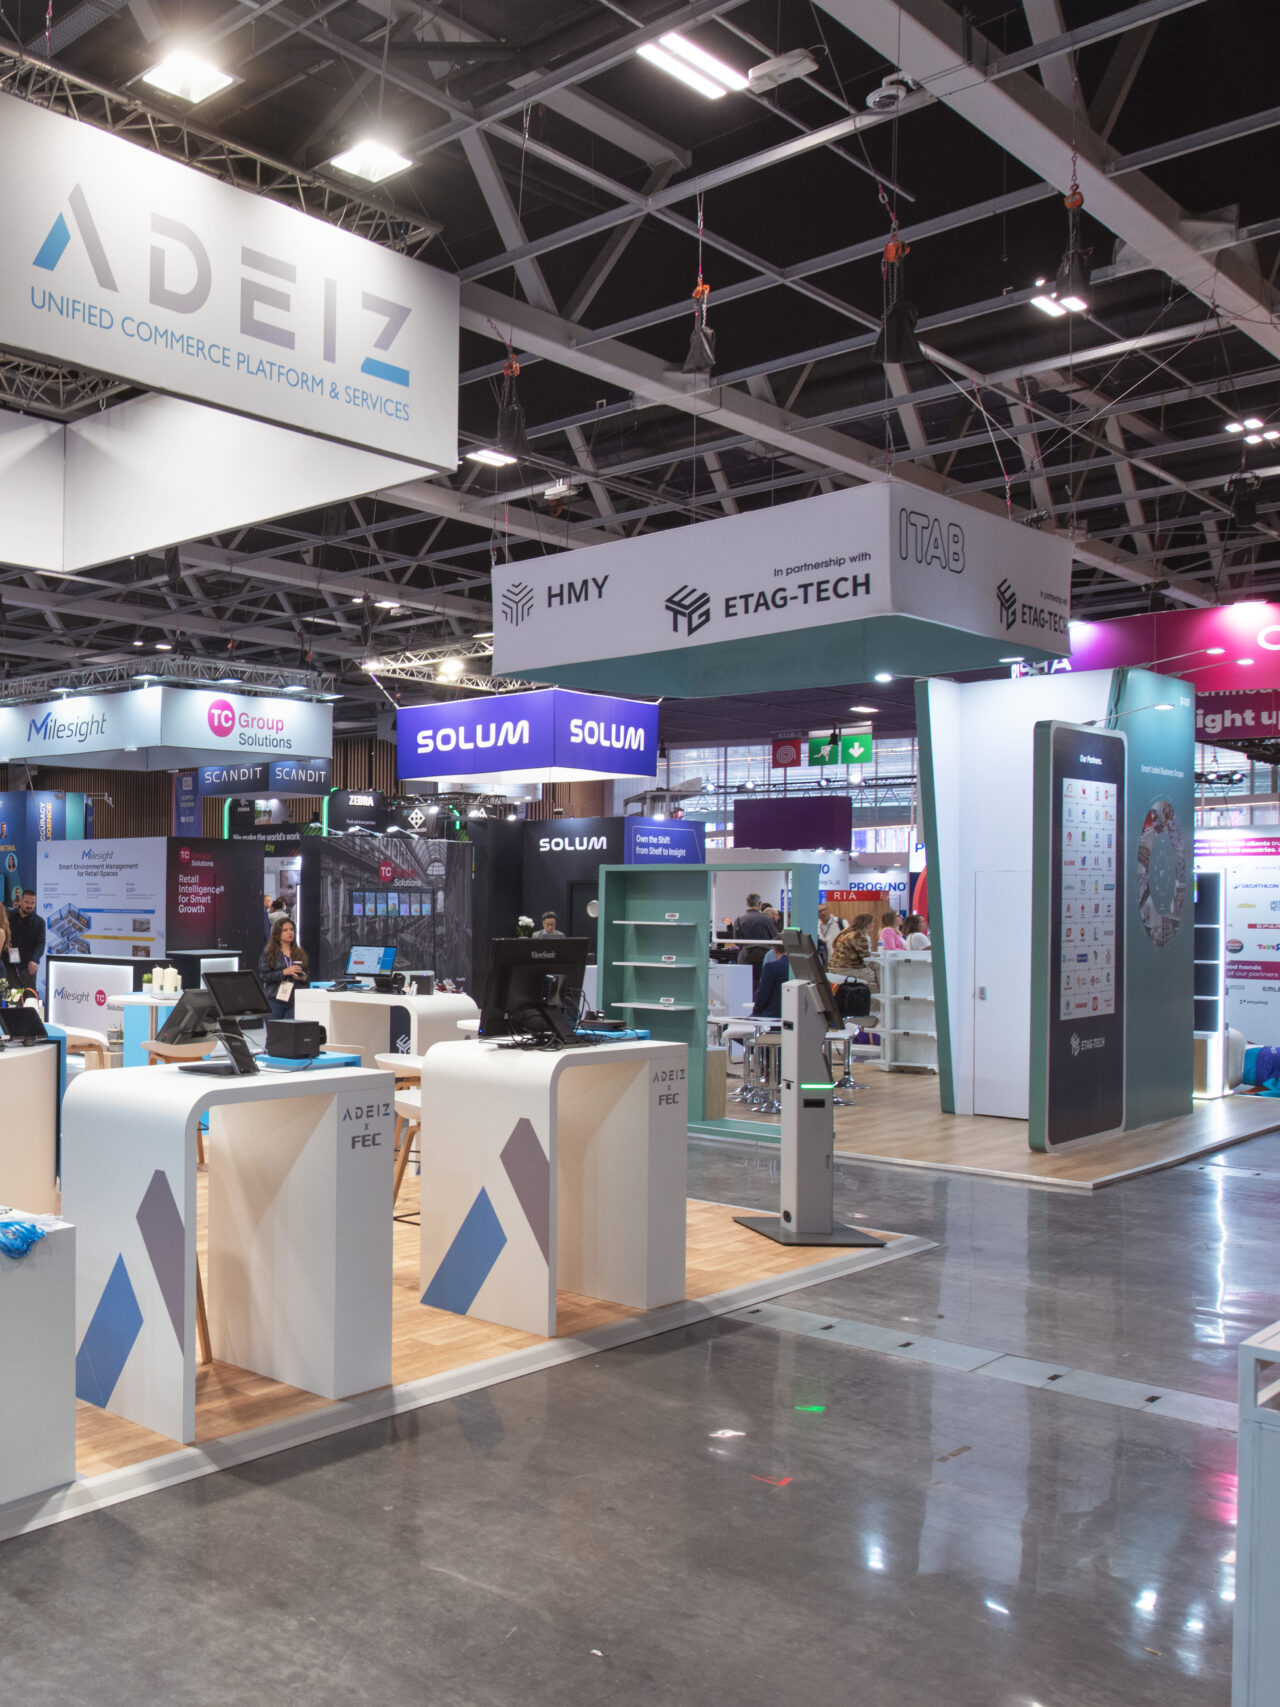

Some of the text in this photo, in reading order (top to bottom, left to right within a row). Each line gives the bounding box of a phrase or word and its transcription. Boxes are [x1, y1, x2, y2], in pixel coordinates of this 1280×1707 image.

[31, 183, 412, 387] ADEIZ
[31, 286, 410, 422] UNIFIED COMMERCE PLATFORM & SERVICES
[898, 507, 965, 574] ITAB
[773, 551, 872, 577] In partnership with
[546, 574, 610, 609] HMY
[724, 573, 871, 618] ETAG-TECH
[27, 711, 107, 743] Milesight
[210, 708, 284, 734] TC Group
[1196, 709, 1255, 734] ight
[238, 732, 292, 749] Solutions
[416, 719, 529, 754] SOLUM
[569, 718, 645, 751] SOLUM
[204, 767, 262, 784] SCANDIT
[275, 767, 326, 783] SCANDIT
[266, 832, 286, 841] world's
[286, 832, 300, 840] work
[539, 836, 607, 852] SOLUM
[636, 834, 670, 844] Own the Shift
[81, 848, 114, 861] Milesight
[180, 851, 190, 859] TC
[636, 846, 648, 855] from
[649, 846, 662, 855] Shelf
[663, 848, 669, 856] to
[105, 863, 139, 871] Management
[380, 867, 392, 877] TC
[178, 874, 199, 883] Retail
[178, 895, 211, 904] for Smart
[833, 892, 857, 900] RIA
[178, 904, 205, 913] Growth
[53, 986, 90, 1003] Milesight
[95, 994, 105, 1002] TC
[106, 1004, 124, 1012] Solutio
[653, 1068, 686, 1083] ADEIZ
[658, 1092, 679, 1106] FEC
[343, 1102, 391, 1121] ADEIZ
[351, 1132, 382, 1149] FEC
